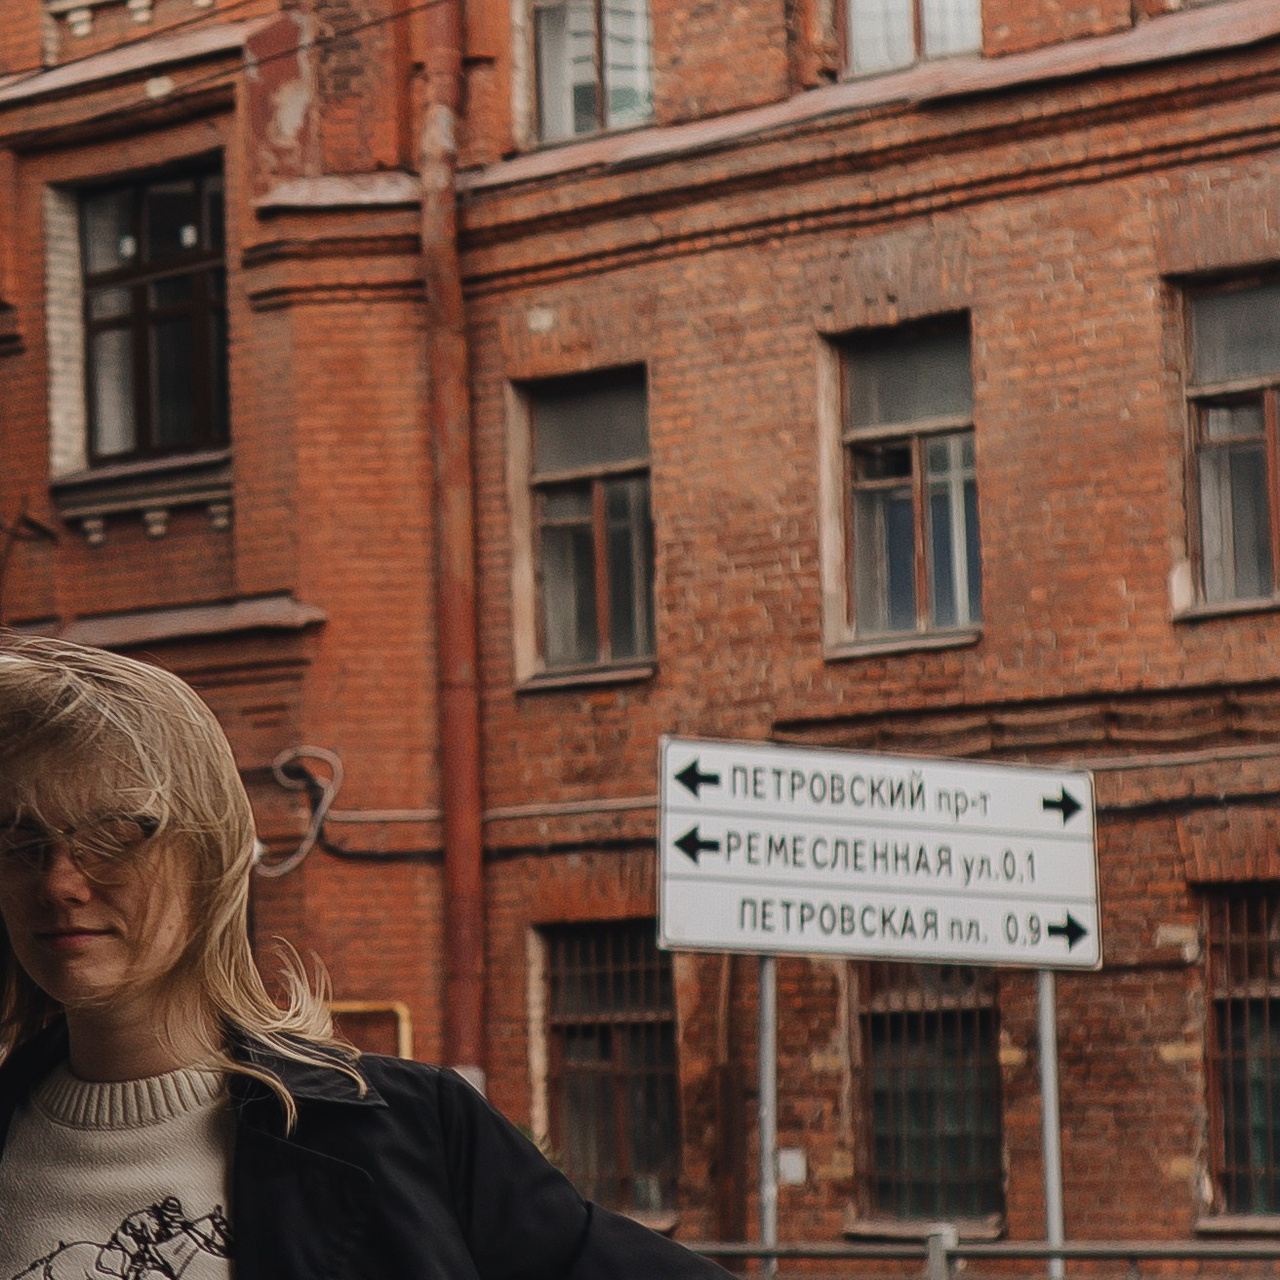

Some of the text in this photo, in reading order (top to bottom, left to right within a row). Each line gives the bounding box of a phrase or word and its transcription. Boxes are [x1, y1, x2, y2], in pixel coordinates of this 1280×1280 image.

[731, 765, 989, 822] ПЕТРОВСКИЙ пр-т
[726, 831, 952, 874] РЕМЕСЛЕННАЯ
[739, 898, 938, 941] ПЕТРОВСКАЯ
[950, 919, 988, 944] пл.
